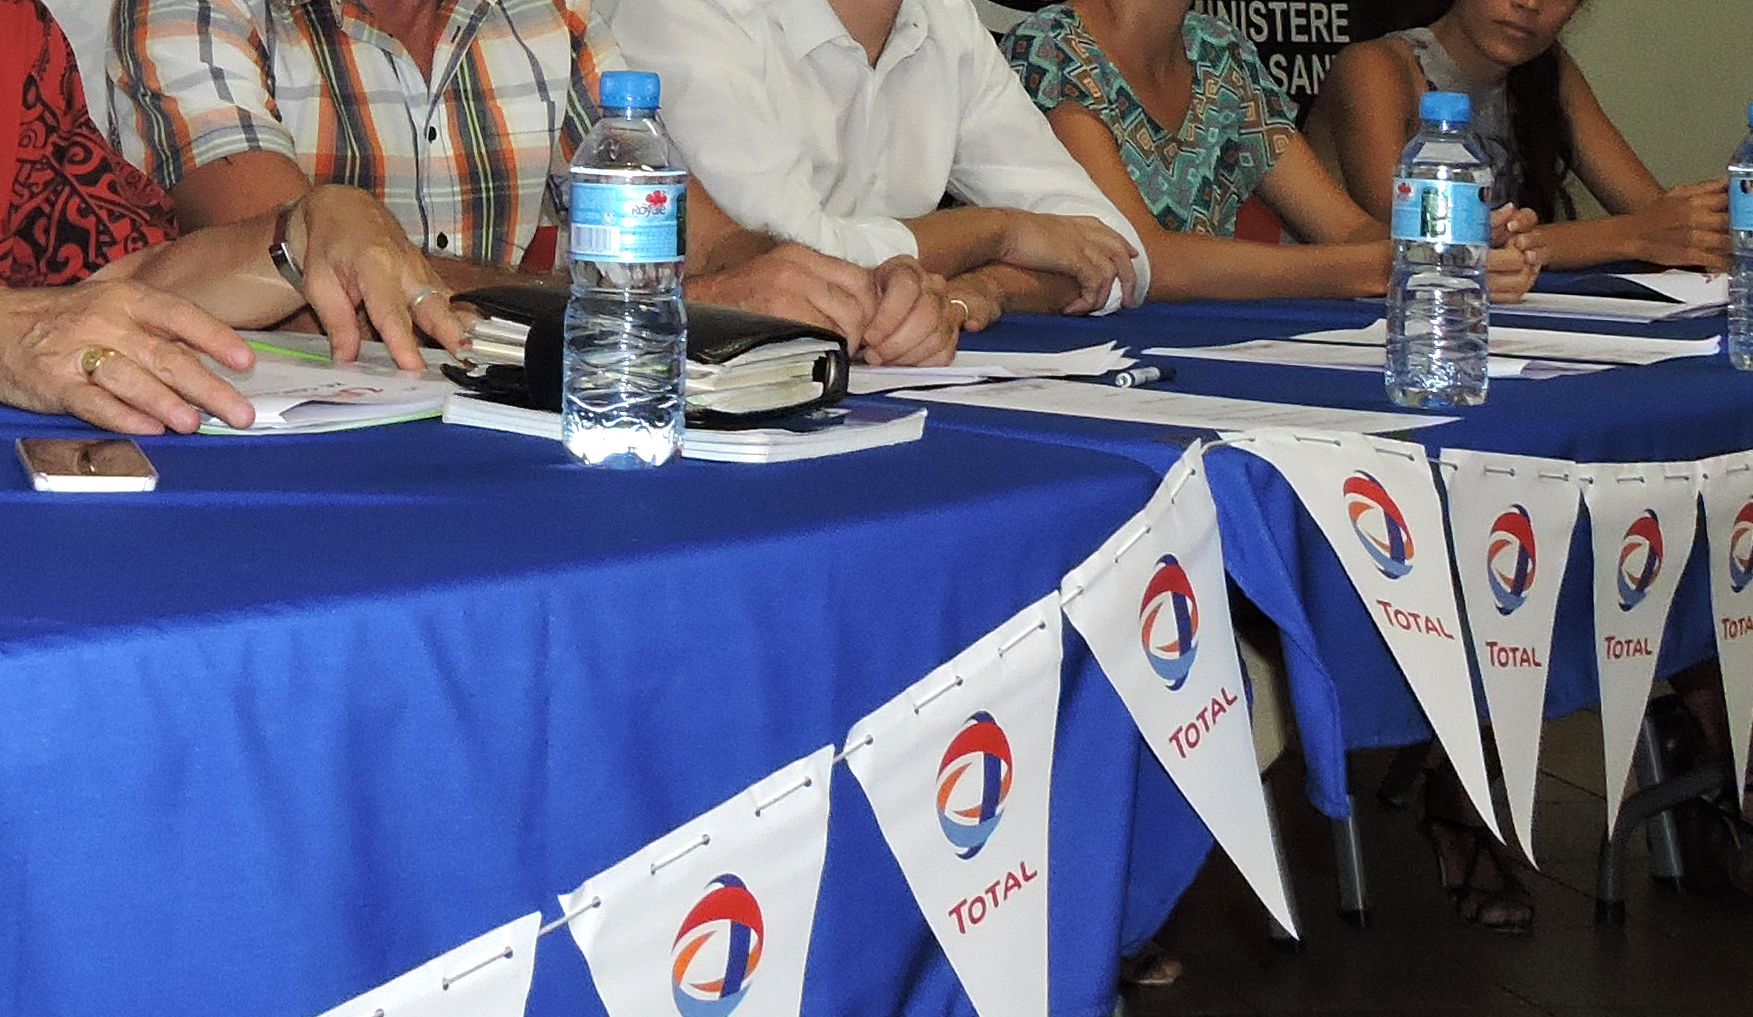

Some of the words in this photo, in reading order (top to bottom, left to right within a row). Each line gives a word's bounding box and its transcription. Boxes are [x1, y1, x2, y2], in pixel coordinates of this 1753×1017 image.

[1376, 599, 1455, 640] TOTAL
[1721, 616, 1753, 641] TOTA
[1485, 641, 1542, 668] TOTAL
[1605, 636, 1653, 660] TOTAL
[1169, 687, 1238, 758] TOTAL
[948, 861, 1038, 934] TOTAL
